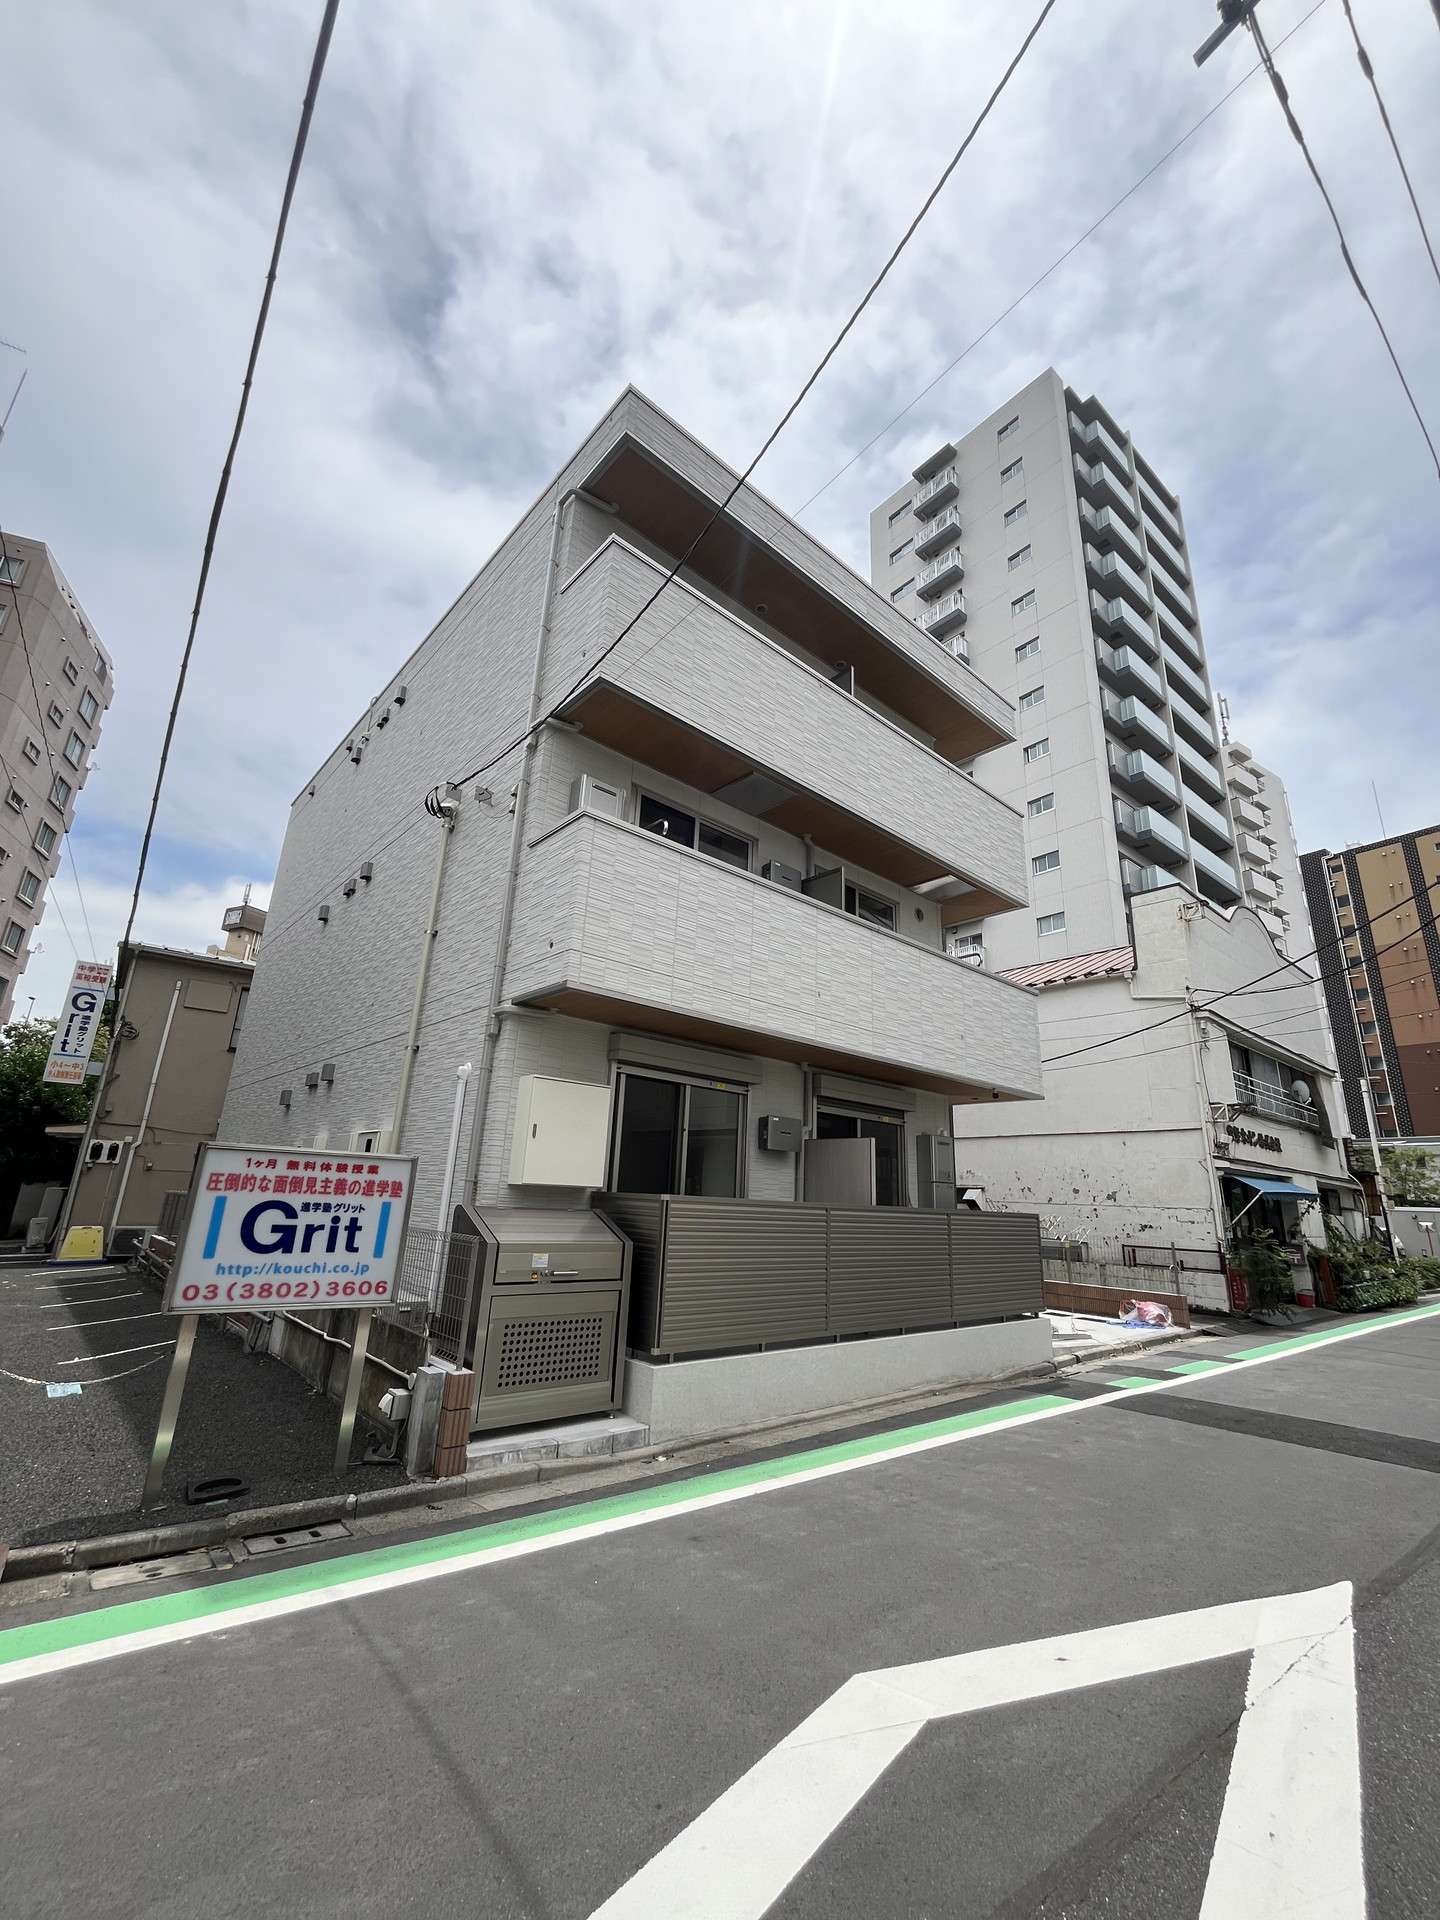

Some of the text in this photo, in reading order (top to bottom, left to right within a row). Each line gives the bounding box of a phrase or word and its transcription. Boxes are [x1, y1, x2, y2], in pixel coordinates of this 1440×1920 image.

[75, 973, 108, 985] 高校受験
[60, 992, 97, 1053] Grit
[286, 1160, 380, 1175] 無料体験授業
[206, 1172, 404, 1198] 圧倒的な面倒見主義の進学塾
[300, 1201, 366, 1213] 進学塾グリット
[240, 1199, 363, 1255] Grit
[216, 1262, 370, 1277] http://kouchi.co.jp
[182, 1280, 389, 1302] 03(3802)3606
